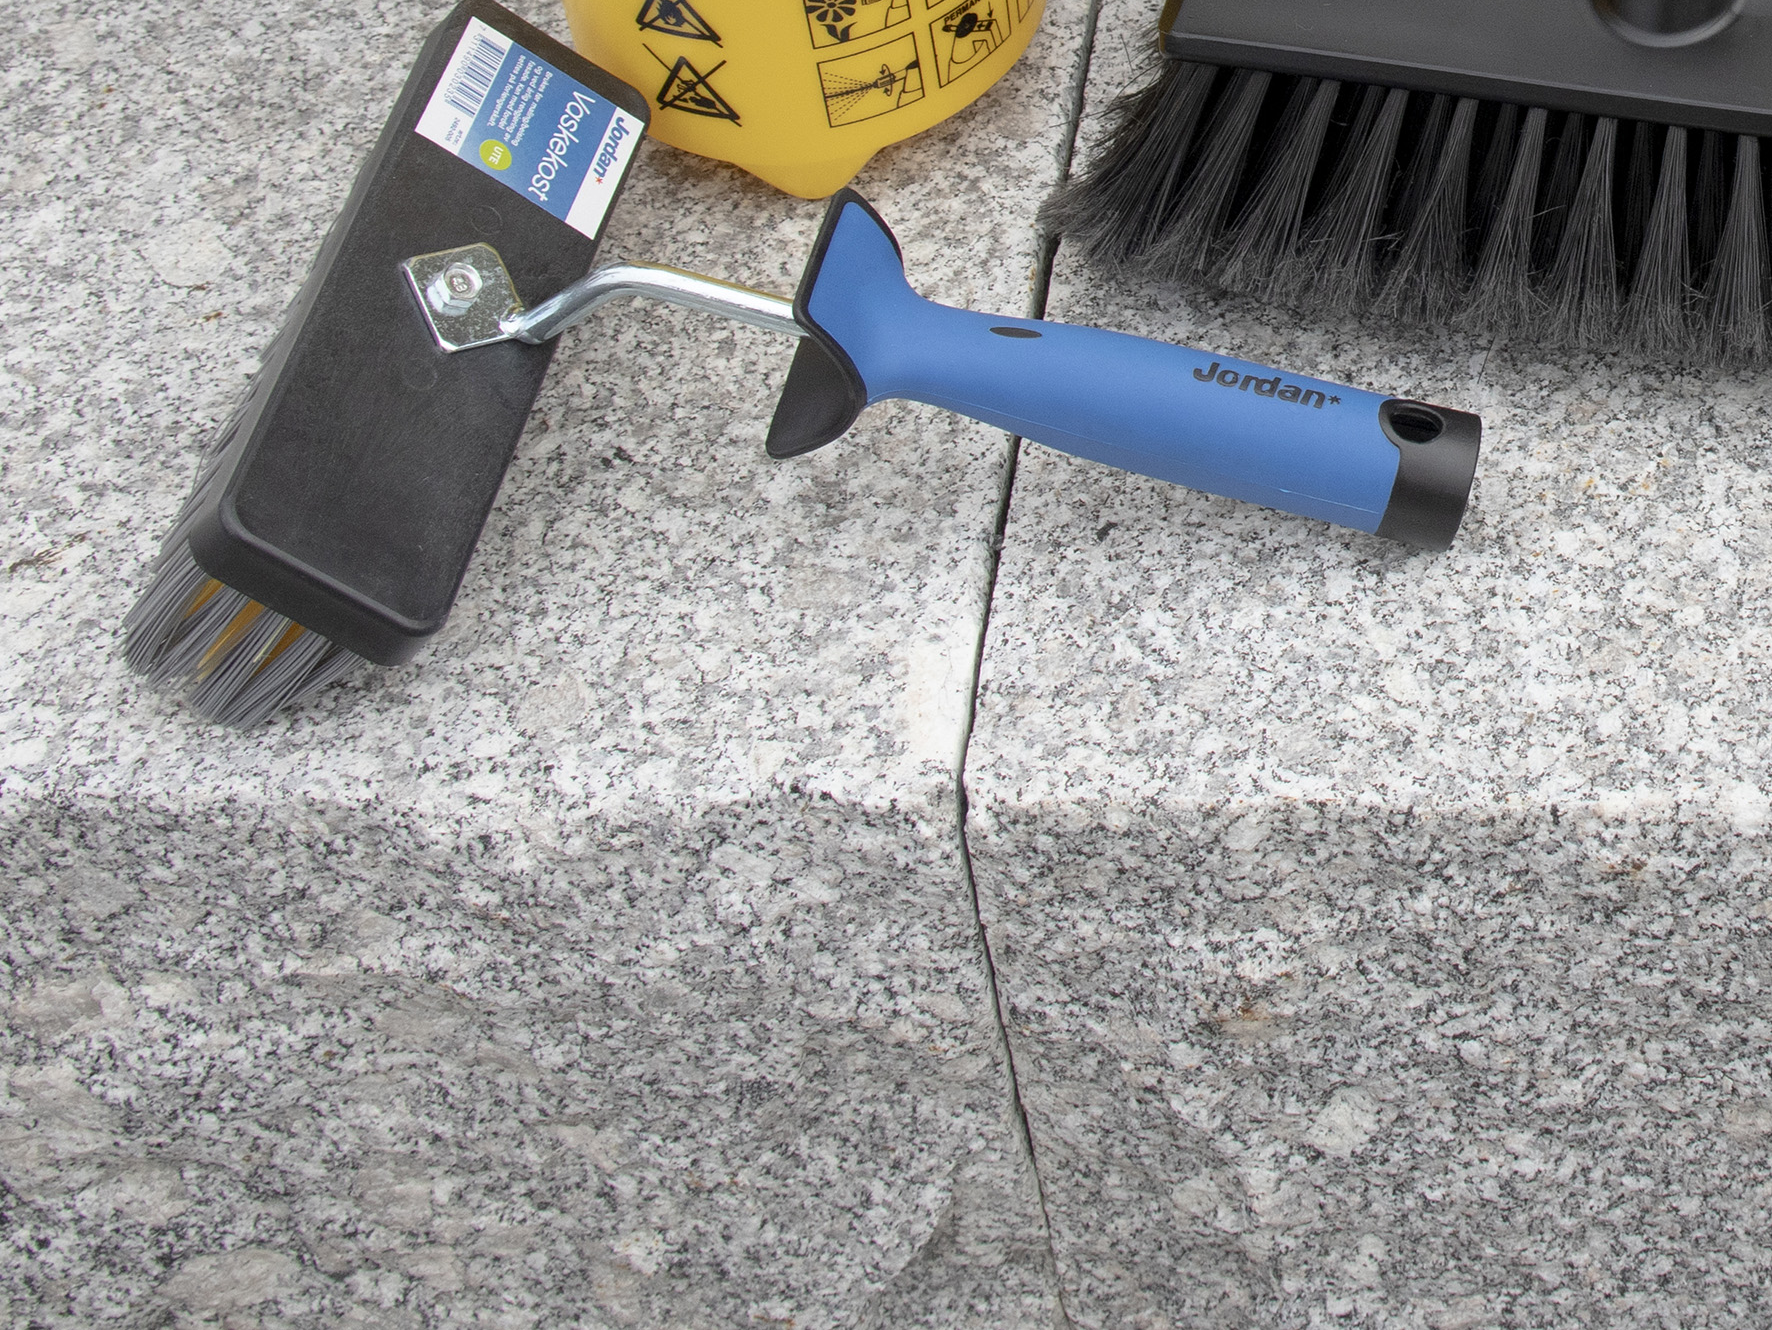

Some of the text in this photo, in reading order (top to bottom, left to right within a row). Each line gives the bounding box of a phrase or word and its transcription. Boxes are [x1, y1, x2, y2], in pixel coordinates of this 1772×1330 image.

[513, 54, 526, 74] settes
[533, 65, 544, 75] og
[508, 73, 516, 84] på
[529, 75, 540, 88] ved
[498, 60, 536, 130] fasade. Kan med fordel
[505, 101, 526, 133] rengjøring
[511, 71, 553, 146] Brukes før maling/beising
[503, 132, 511, 142] av
[528, 91, 596, 202] Vaskekost
[593, 116, 630, 177] Jordan
[488, 146, 504, 165] UTE
[1193, 362, 1325, 409] Jordan
